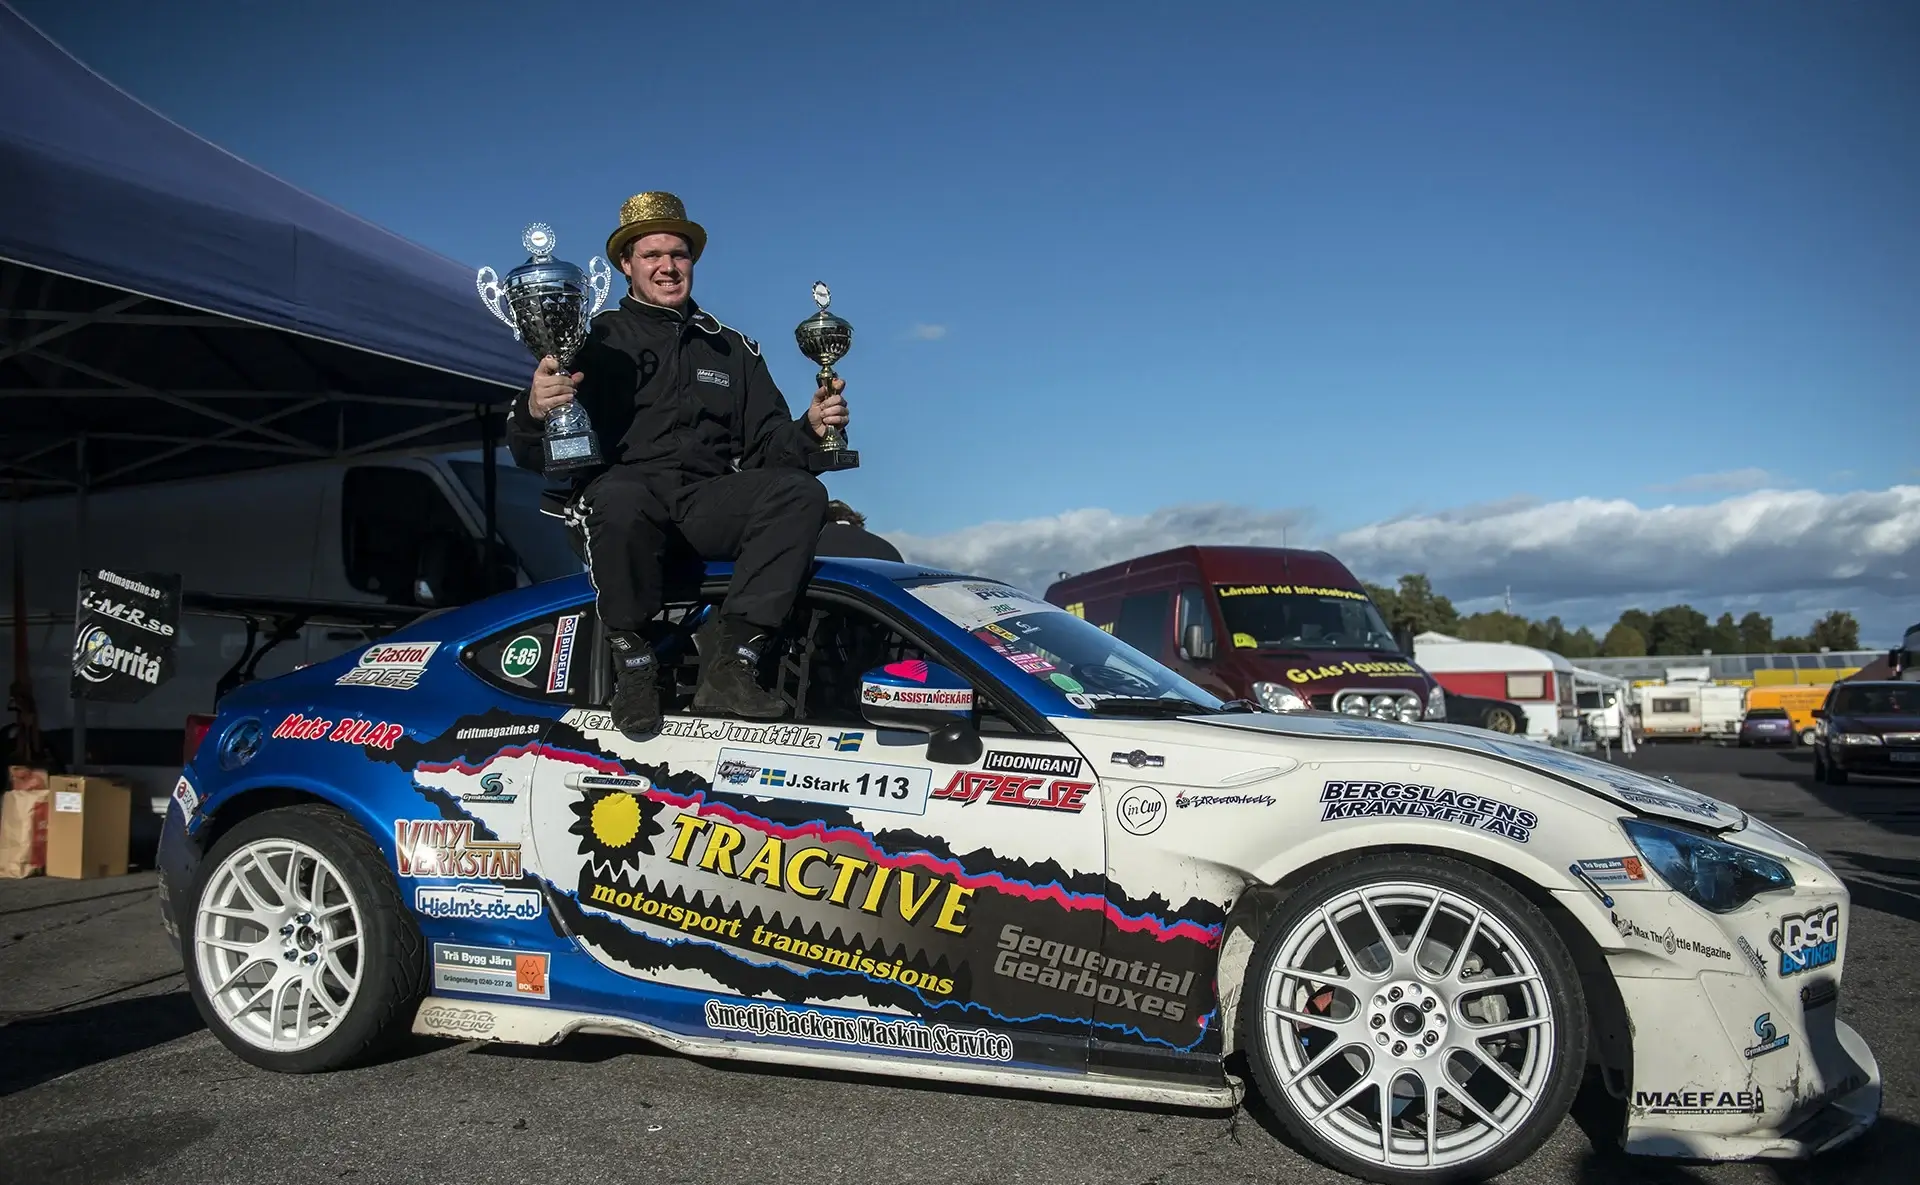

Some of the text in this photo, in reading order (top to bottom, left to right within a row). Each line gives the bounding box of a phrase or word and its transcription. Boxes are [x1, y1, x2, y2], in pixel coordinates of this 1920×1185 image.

[98, 569, 161, 599] driftmagazine.se
[1271, 585, 1292, 594] vid
[377, 646, 430, 664] Castrol
[505, 647, 538, 666] E-85
[554, 636, 571, 689] BILDELAR
[341, 668, 425, 688] EDGE
[272, 713, 403, 750] Mats BILAR
[456, 724, 540, 740] driftmagazine.se
[569, 711, 621, 731] Jen
[718, 761, 761, 778] DRIFT
[729, 774, 750, 784] SM
[786, 772, 910, 800] J.Stark 113
[1127, 799, 1161, 816] in Cup
[1320, 781, 1538, 830] BERGSLAGENS
[396, 820, 521, 850] VINYL
[1321, 799, 1530, 843] KRANLYFT AB
[668, 813, 977, 935] TRACTIVE
[421, 896, 537, 917] Hjelm's rör ab
[591, 880, 956, 995] motorsport transmissions
[1633, 926, 1650, 941] Max
[1692, 940, 1732, 960] Magazine
[1784, 908, 1838, 952] DSG
[443, 951, 512, 966] Trä Bygg Järn
[997, 923, 1195, 996] Sequential
[518, 983, 544, 992] BOLIST
[994, 950, 1187, 1022] Gearboxes
[706, 1000, 1013, 1061] Smedjebackens Maskin Service
[1636, 1091, 1755, 1107] MAEFAB
